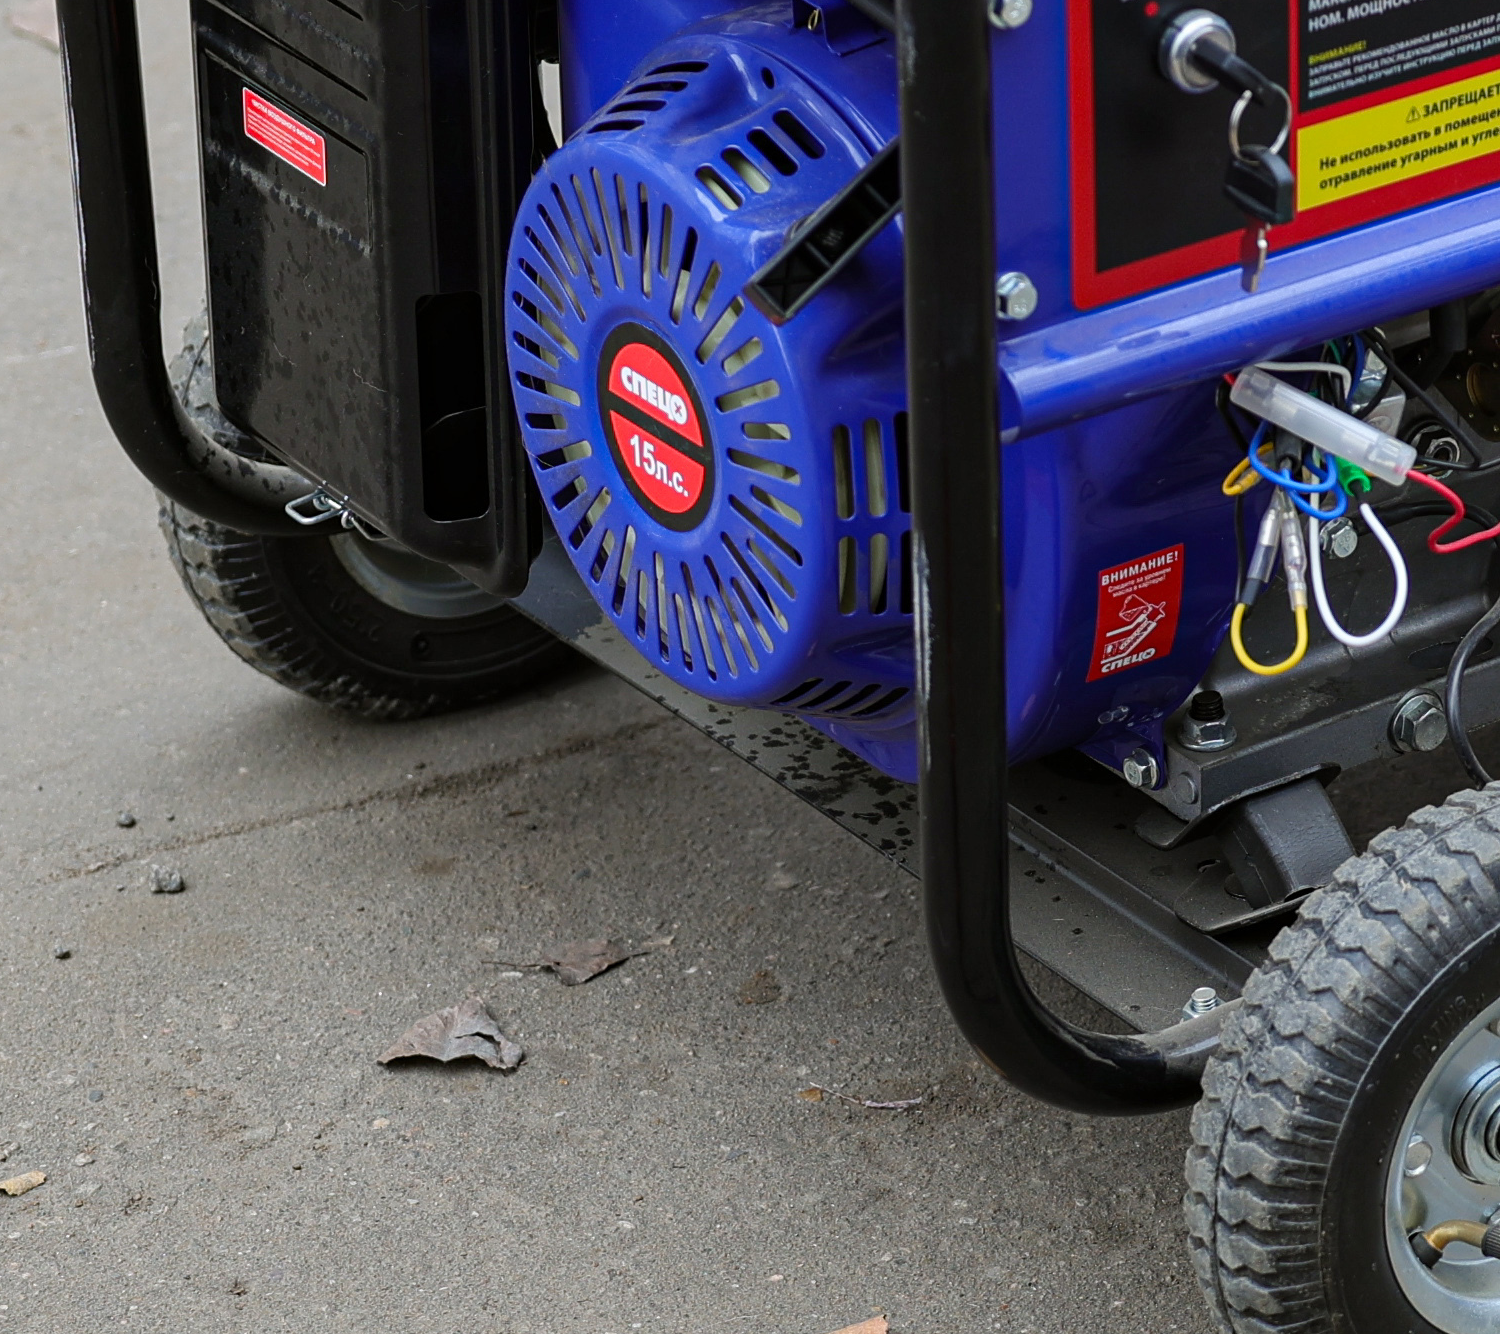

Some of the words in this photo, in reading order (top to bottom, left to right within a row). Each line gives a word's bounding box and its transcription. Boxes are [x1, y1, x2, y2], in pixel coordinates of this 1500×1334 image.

[1308, 10, 1345, 33] НОМ.
[1319, 157, 1397, 190] отравление
[1400, 139, 1458, 171] угарным
[1461, 136, 1469, 147] и
[1320, 155, 1337, 171] Не
[1340, 130, 1431, 165] использовать
[1434, 125, 1442, 135] в
[630, 434, 689, 498] 15л.с.
[1102, 551, 1178, 586] ВНИМАНИЕ!
